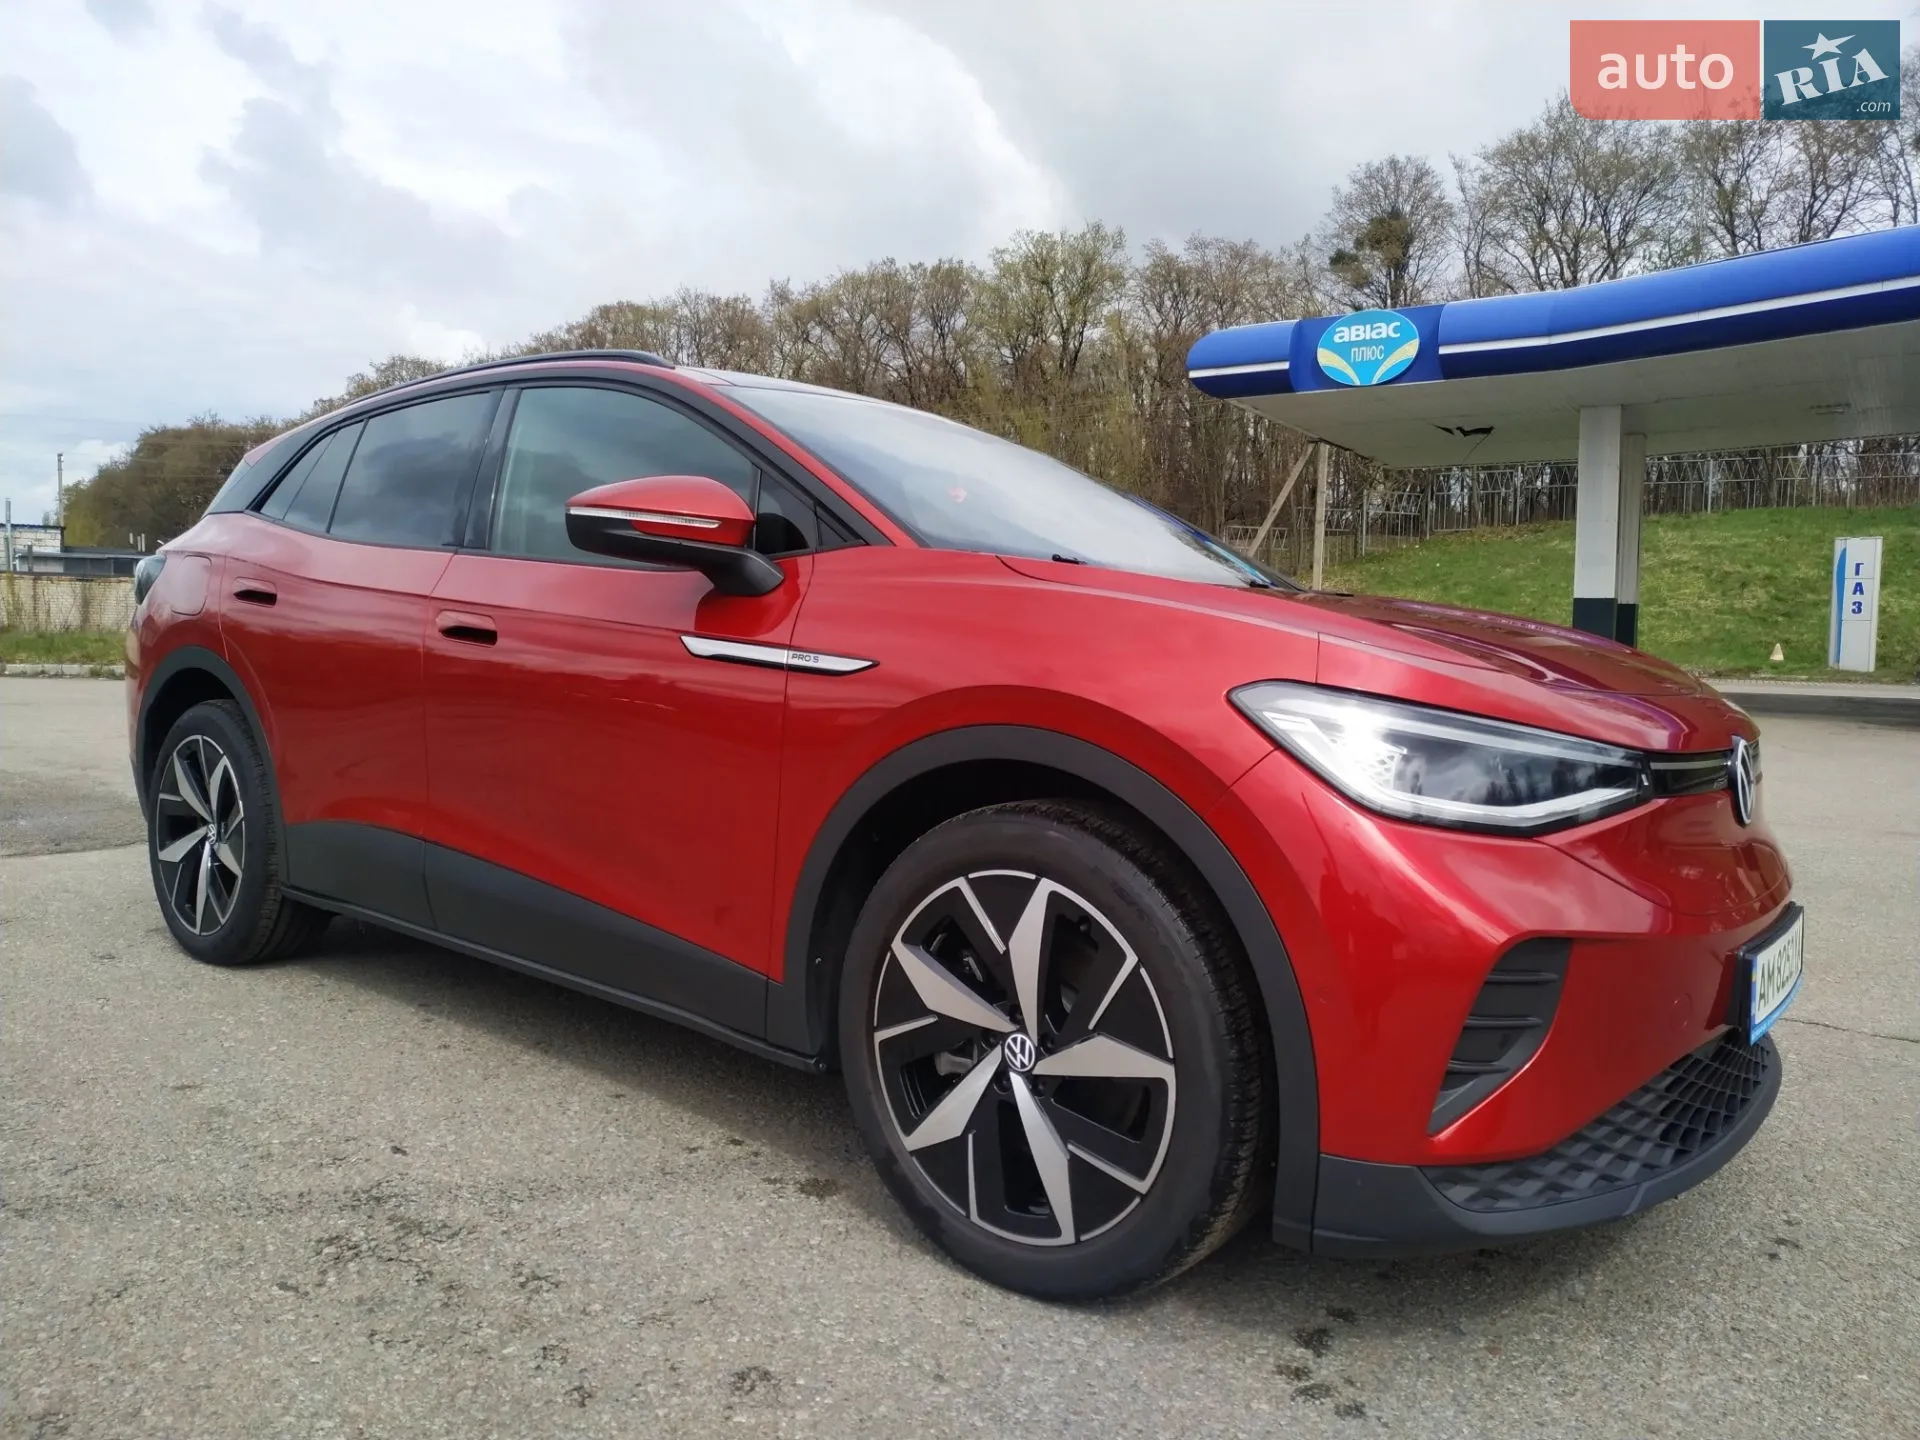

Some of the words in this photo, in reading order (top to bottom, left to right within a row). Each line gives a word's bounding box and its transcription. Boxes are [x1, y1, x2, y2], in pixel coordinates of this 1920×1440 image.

[1851, 562, 1865, 614] ГАЗ
[791, 653, 812, 662] PRO
[812, 655, 820, 664] S
